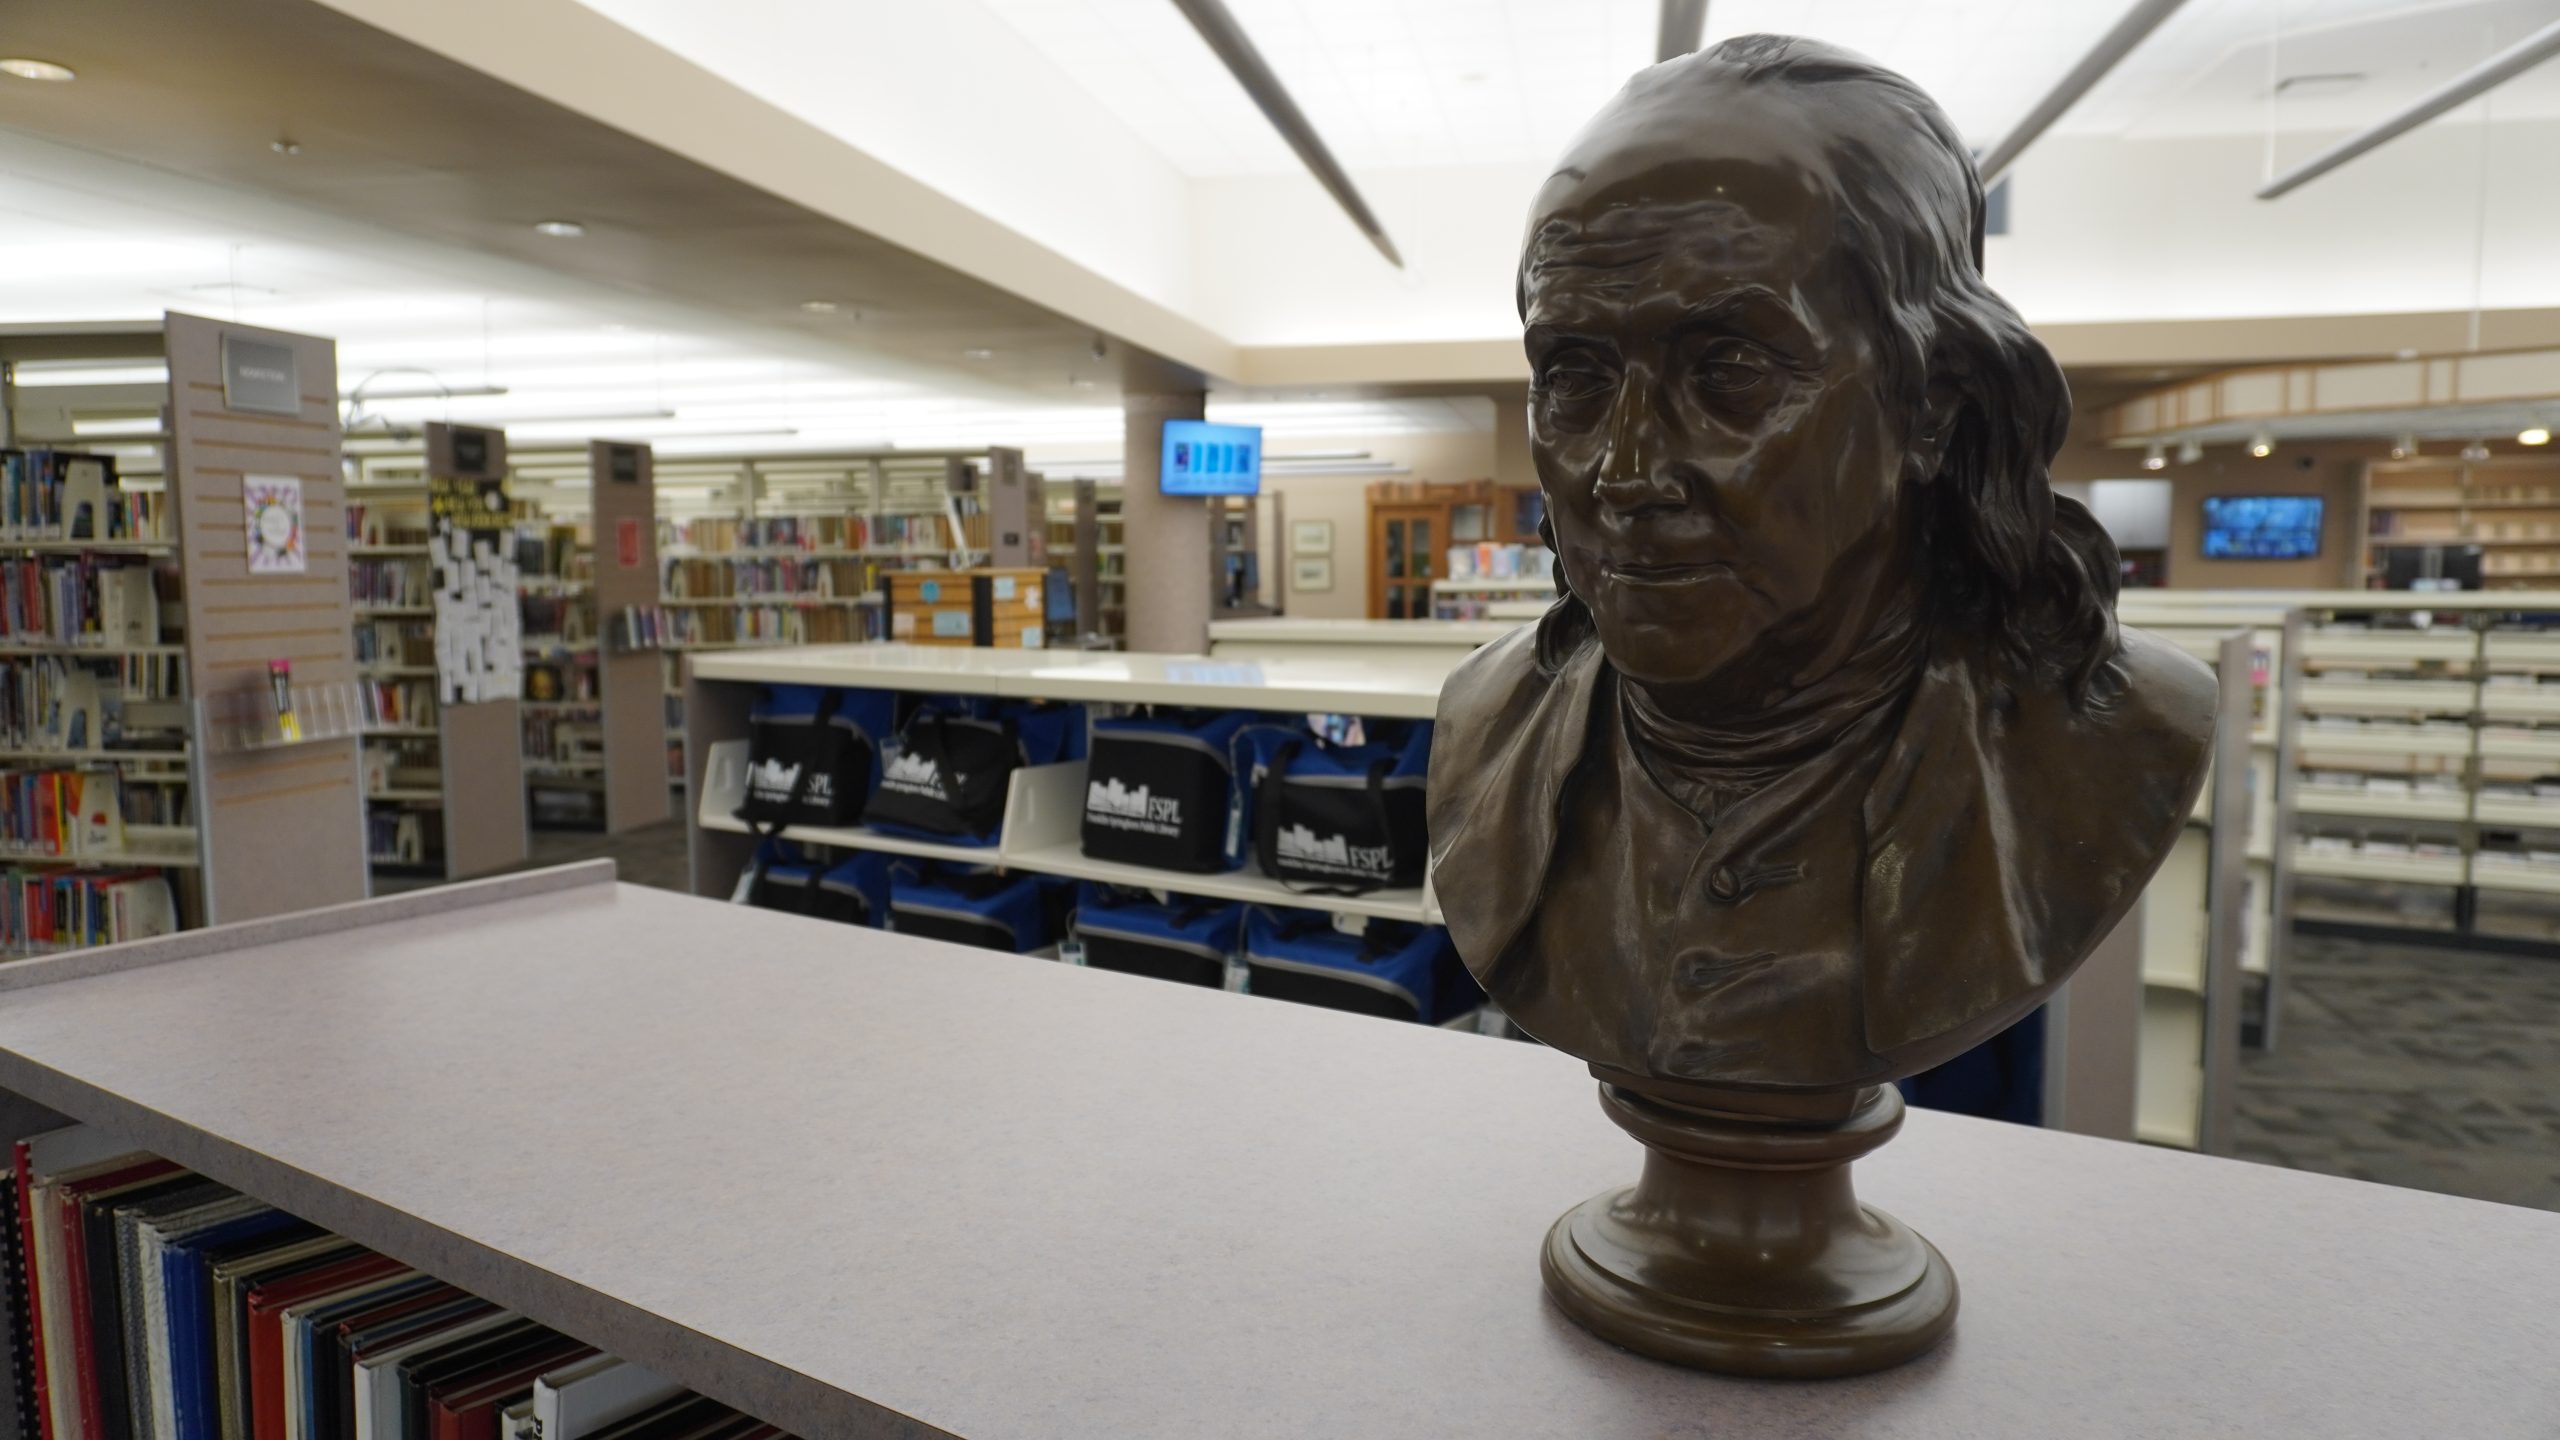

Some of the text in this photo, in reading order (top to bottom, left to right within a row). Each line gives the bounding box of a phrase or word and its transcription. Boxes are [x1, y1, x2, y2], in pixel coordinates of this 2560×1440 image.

[808, 772, 833, 793] SPL
[1150, 797, 1182, 823] FSPL
[1349, 846, 1394, 869] FSPL
